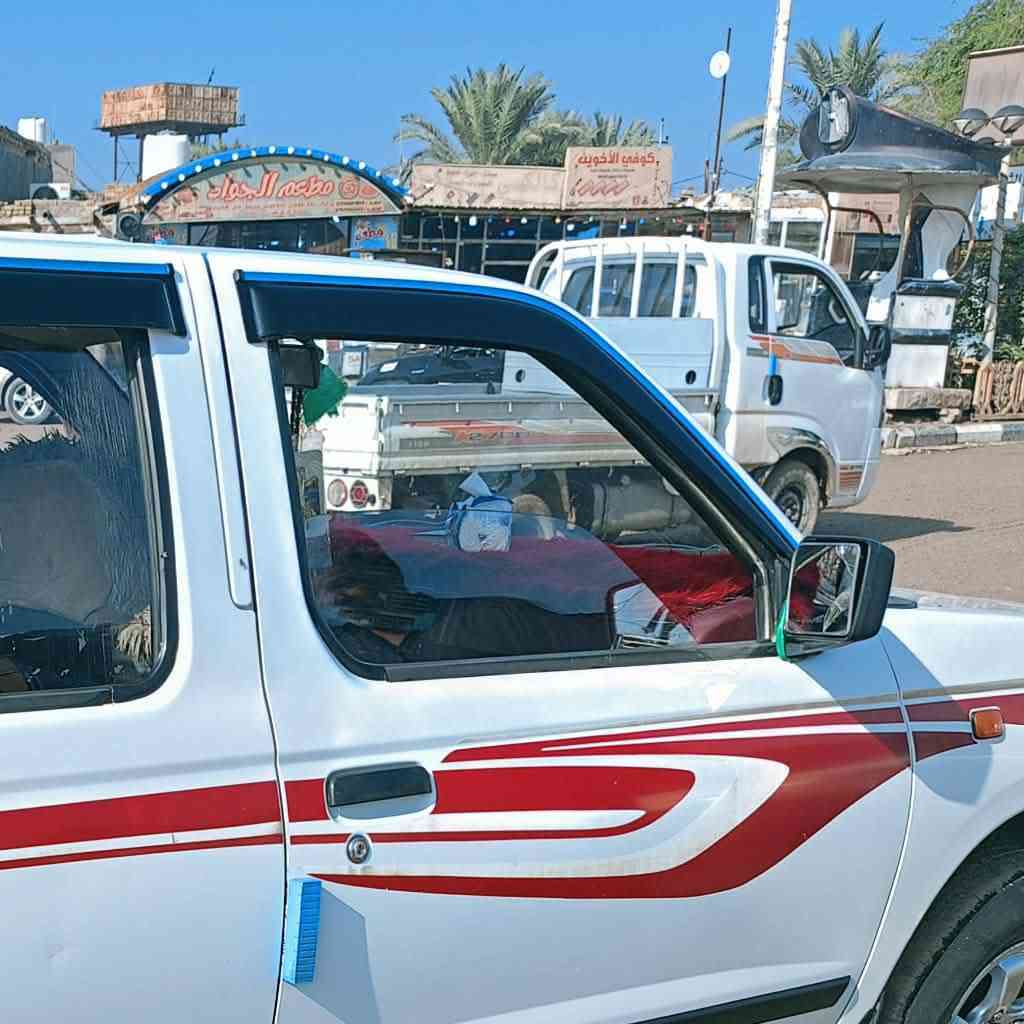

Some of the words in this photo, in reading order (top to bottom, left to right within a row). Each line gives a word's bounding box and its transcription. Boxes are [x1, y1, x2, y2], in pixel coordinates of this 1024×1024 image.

[622, 151, 656, 167] كوفي
[207, 171, 280, 201] الجواد
[280, 176, 336, 199] مطعم
